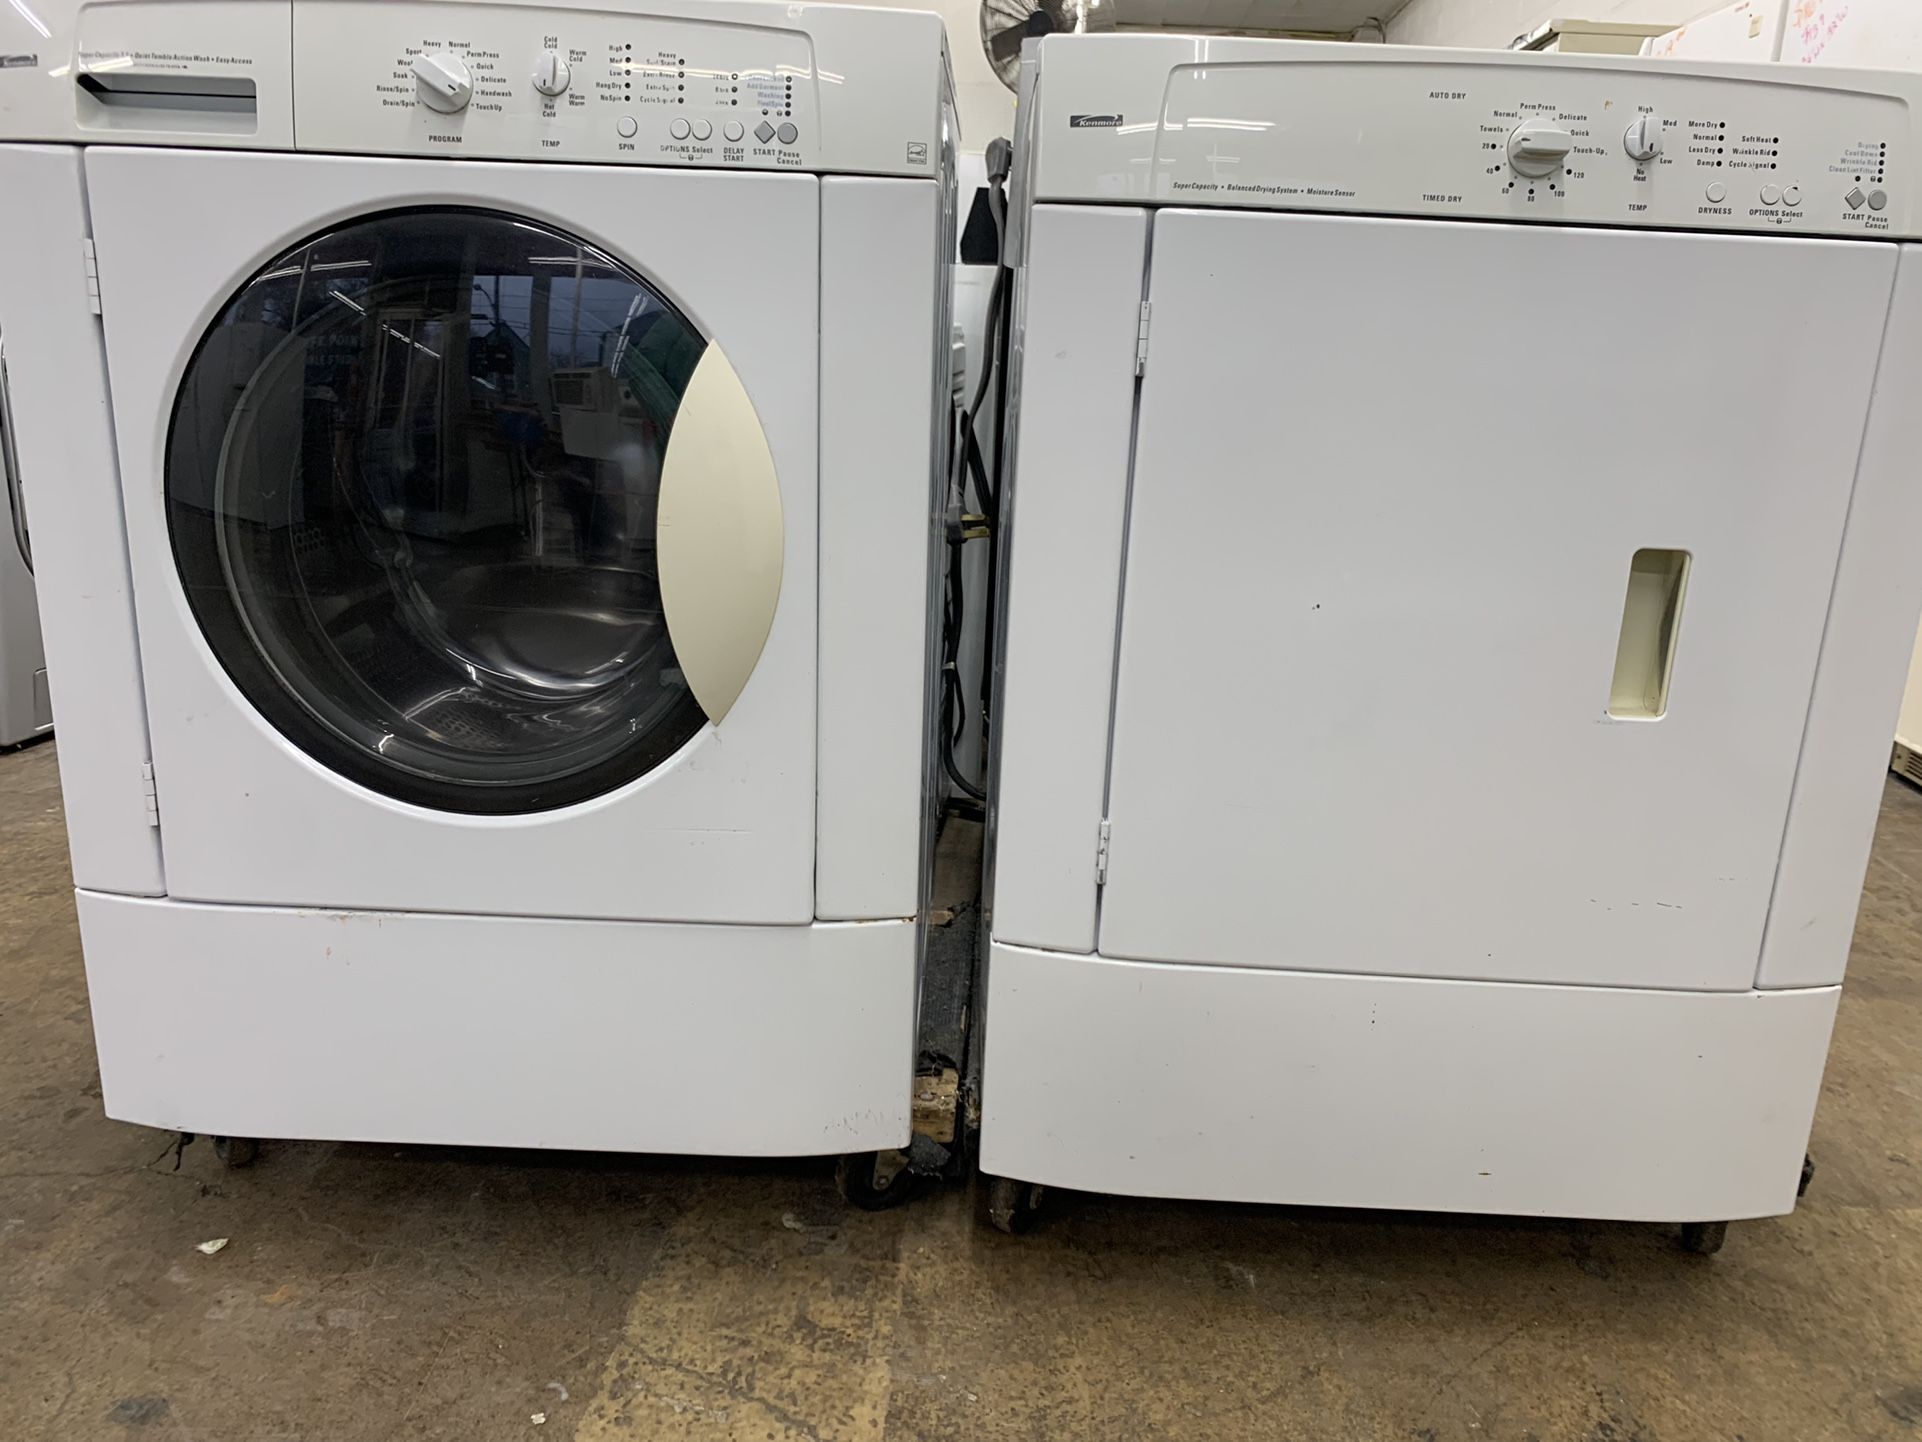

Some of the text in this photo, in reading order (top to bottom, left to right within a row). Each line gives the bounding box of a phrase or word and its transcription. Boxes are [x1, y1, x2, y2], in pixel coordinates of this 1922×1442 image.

[423, 40, 442, 48] Heavy
[376, 85, 409, 93] Rinse/Spin
[382, 99, 415, 107] Drain/Spin
[1520, 102, 1536, 110] Perm
[1706, 122, 1718, 130] Dry
[428, 135, 462, 144] PROGRAM
[692, 146, 713, 154] Select
[778, 150, 800, 158] Pause
[1704, 147, 1716, 155] Dry
[777, 158, 802, 166] Cancel
[1696, 160, 1715, 168] Damp
[1728, 161, 1747, 169] Cycle
[1698, 206, 1732, 215] DRYNESS
[1749, 209, 1803, 218] OPTIONS Select
[1867, 214, 1888, 222] Pause
[1865, 222, 1888, 230] Cancel
